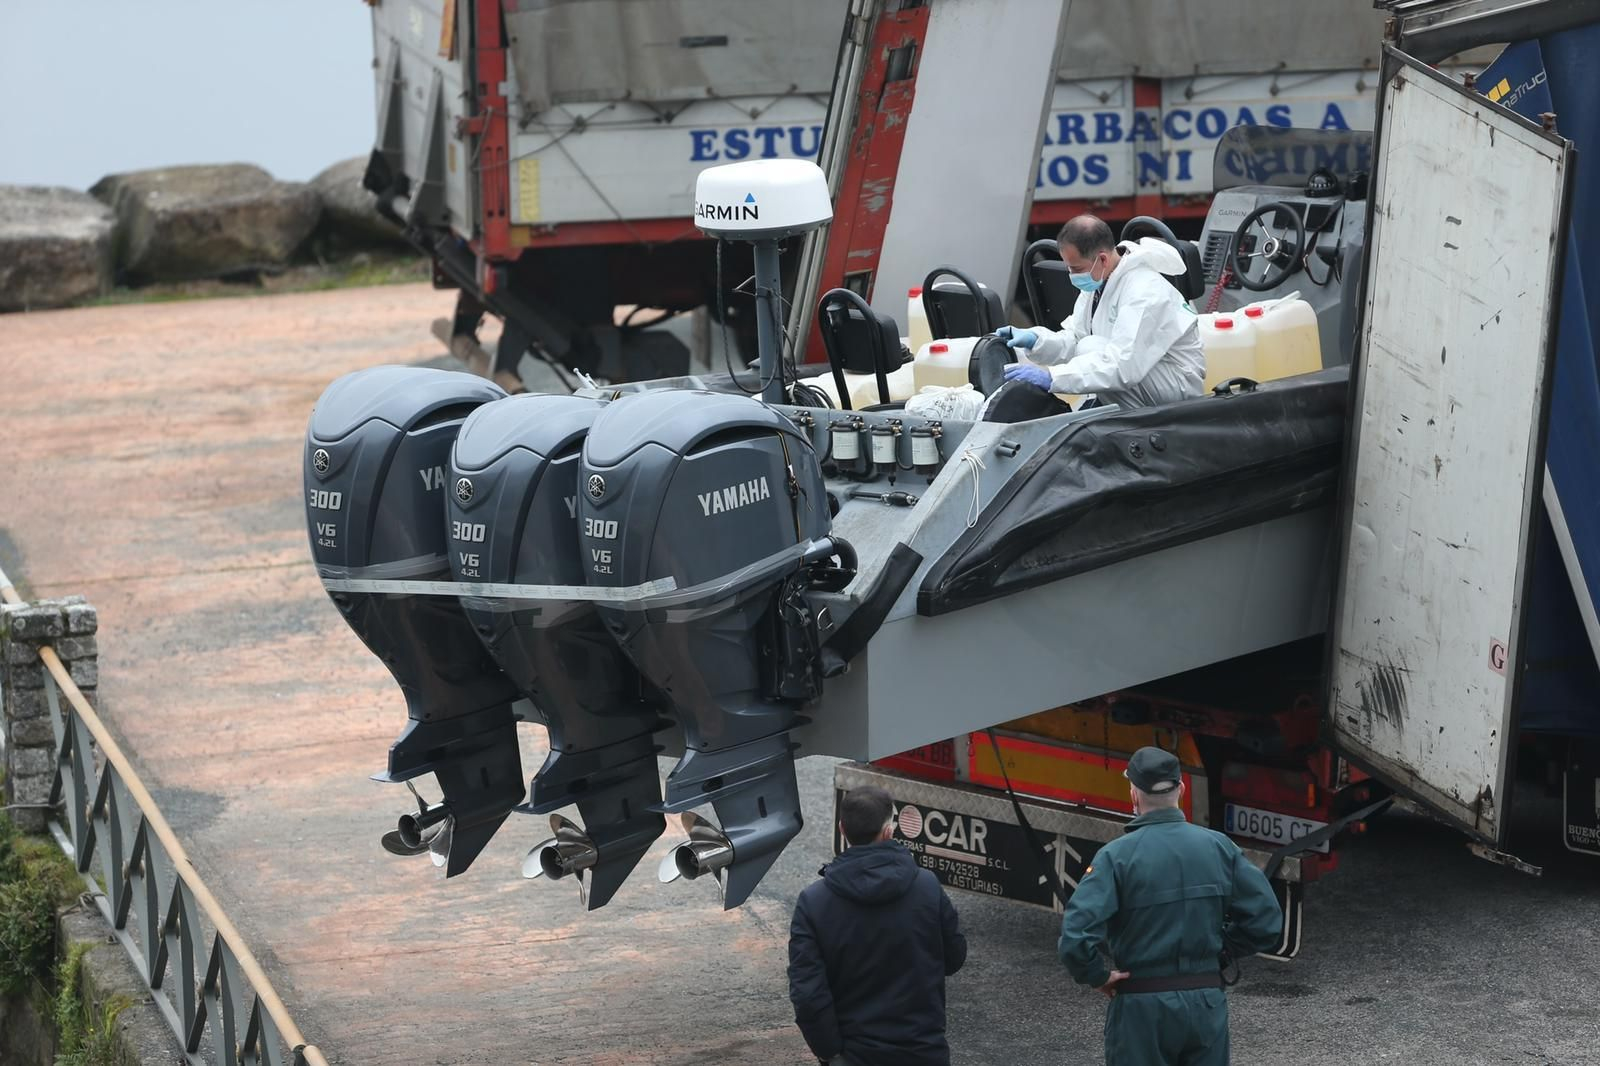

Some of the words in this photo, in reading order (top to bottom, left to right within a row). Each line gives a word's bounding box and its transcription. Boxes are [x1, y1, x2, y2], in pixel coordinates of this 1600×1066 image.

[689, 126, 822, 162] ESTU
[1318, 102, 1352, 134] A
[1138, 150, 1193, 184] NI
[310, 489, 342, 510] 300
[697, 476, 771, 517] YAMAHA
[316, 522, 337, 537] V6
[452, 521, 486, 543] 300
[584, 518, 618, 540] 300
[318, 538, 337, 548] 4.2L
[459, 552, 480, 567] V6
[592, 549, 612, 564] V6
[461, 567, 481, 578] 4.2L
[593, 565, 613, 575] 4.2L
[1491, 644, 1505, 669] G
[1237, 811, 1283, 839] 0605
[947, 874, 1004, 895] (ASTURIAS)
